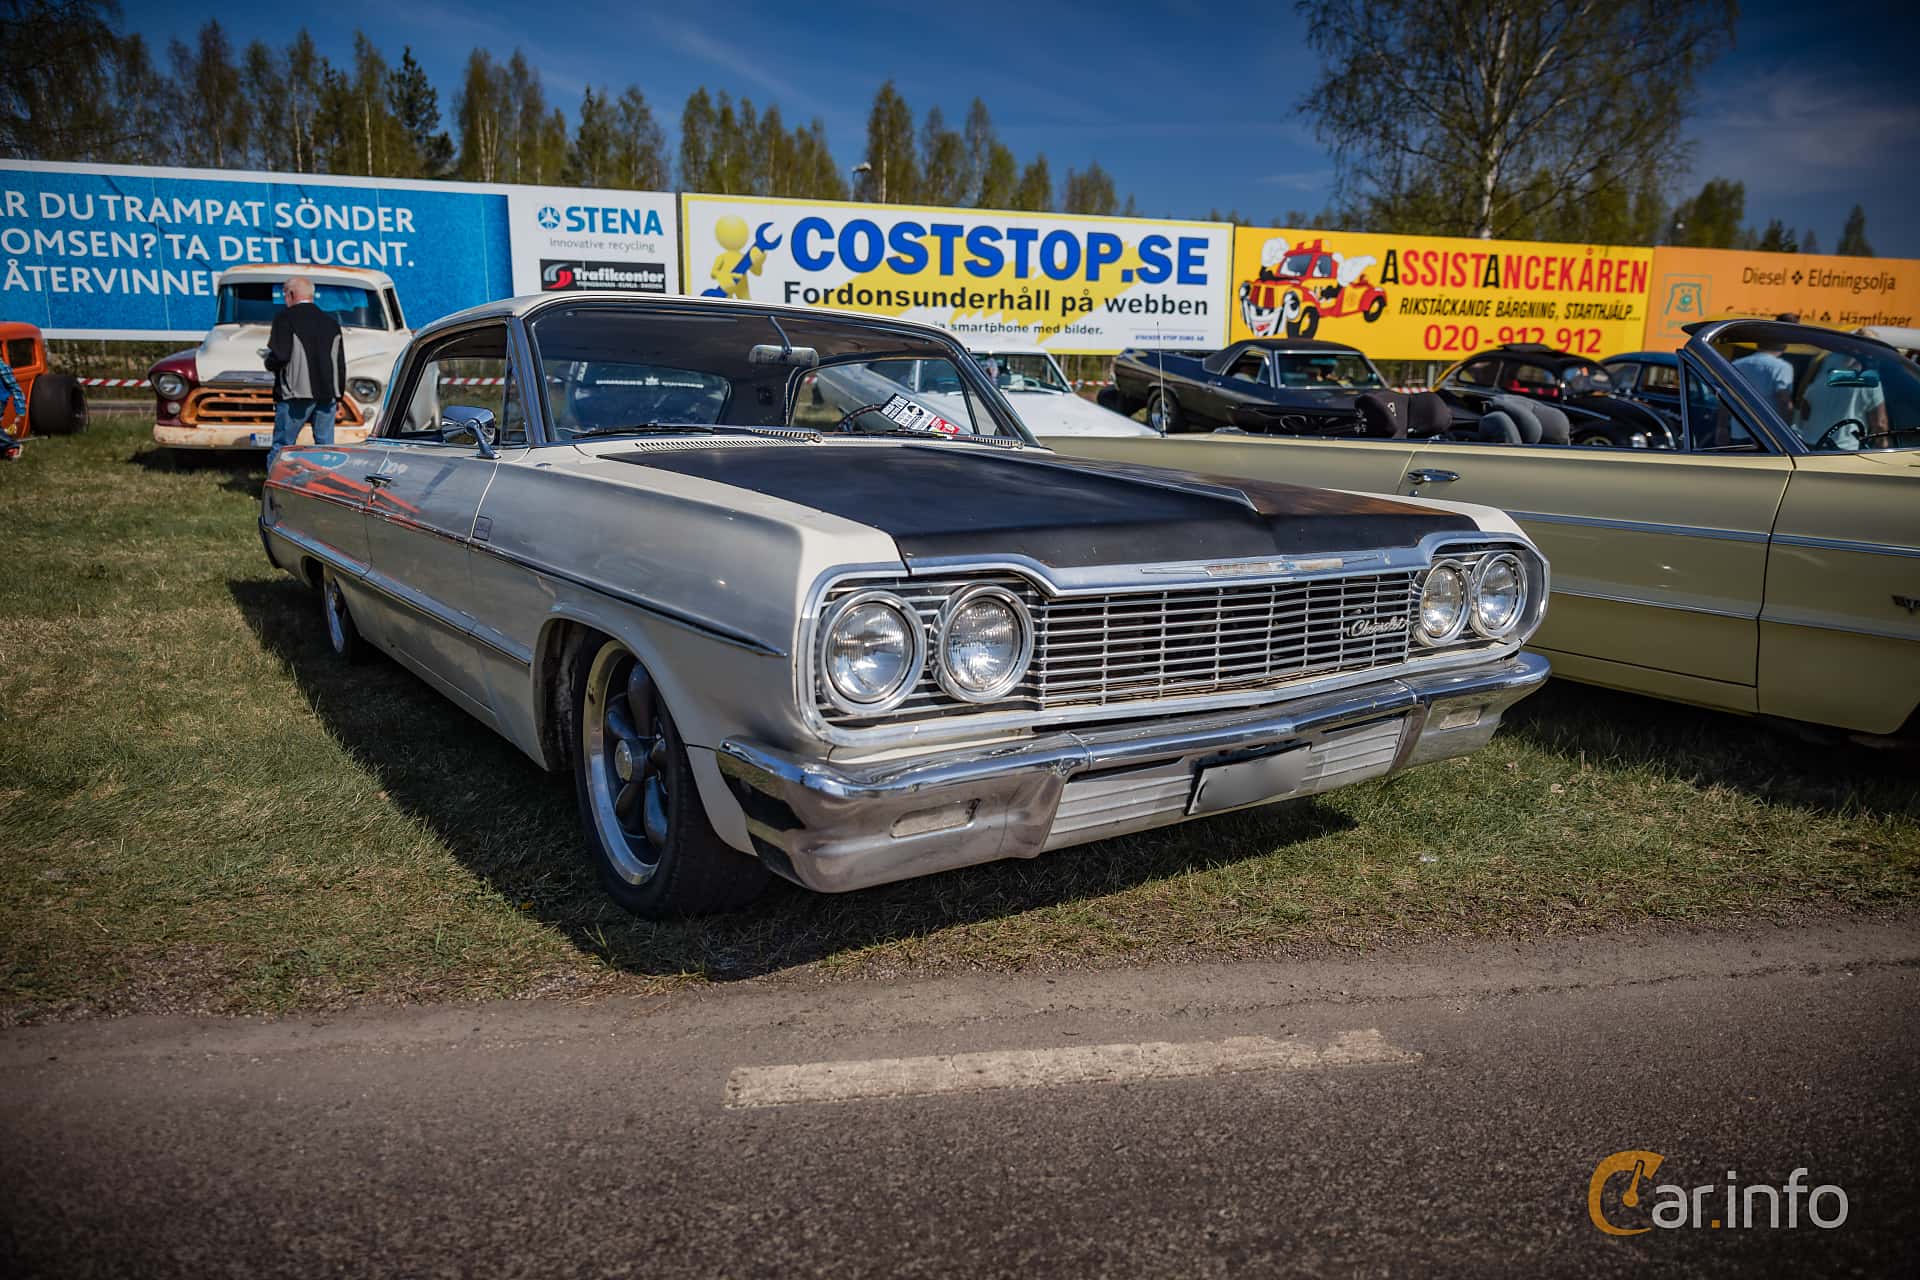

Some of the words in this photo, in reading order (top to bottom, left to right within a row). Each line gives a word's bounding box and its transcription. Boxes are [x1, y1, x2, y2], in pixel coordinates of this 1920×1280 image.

[0, 191, 29, 217] R
[40, 192, 94, 220] DU
[99, 194, 266, 226] TRAMPAT
[276, 199, 416, 233] SÖNDER
[566, 207, 663, 235] STENA
[1, 228, 155, 259] OMSEN?
[165, 234, 210, 260] TA
[219, 236, 284, 262] DET
[294, 239, 415, 268] LUGNT.
[609, 240, 656, 253] recycling
[790, 216, 1209, 286] COSTSTOP.SE
[573, 267, 664, 283] Trafikcenter
[1380, 248, 1648, 294] ASSISTANCEKÅREN
[1742, 268, 1786, 286] Diesel
[1807, 269, 1896, 294] Eldningsolja
[784, 281, 1050, 312] Fordonsunderhåll
[1061, 289, 1094, 316] på
[1105, 294, 1209, 316] webben
[1400, 294, 1491, 317] RIKSTÄCKANDE
[1496, 297, 1559, 322] BÄRGNING,
[951, 322, 1029, 335] smartphone
[1034, 325, 1060, 334] med
[1065, 325, 1103, 335] bilder.
[1556, 328, 1602, 353] 912
